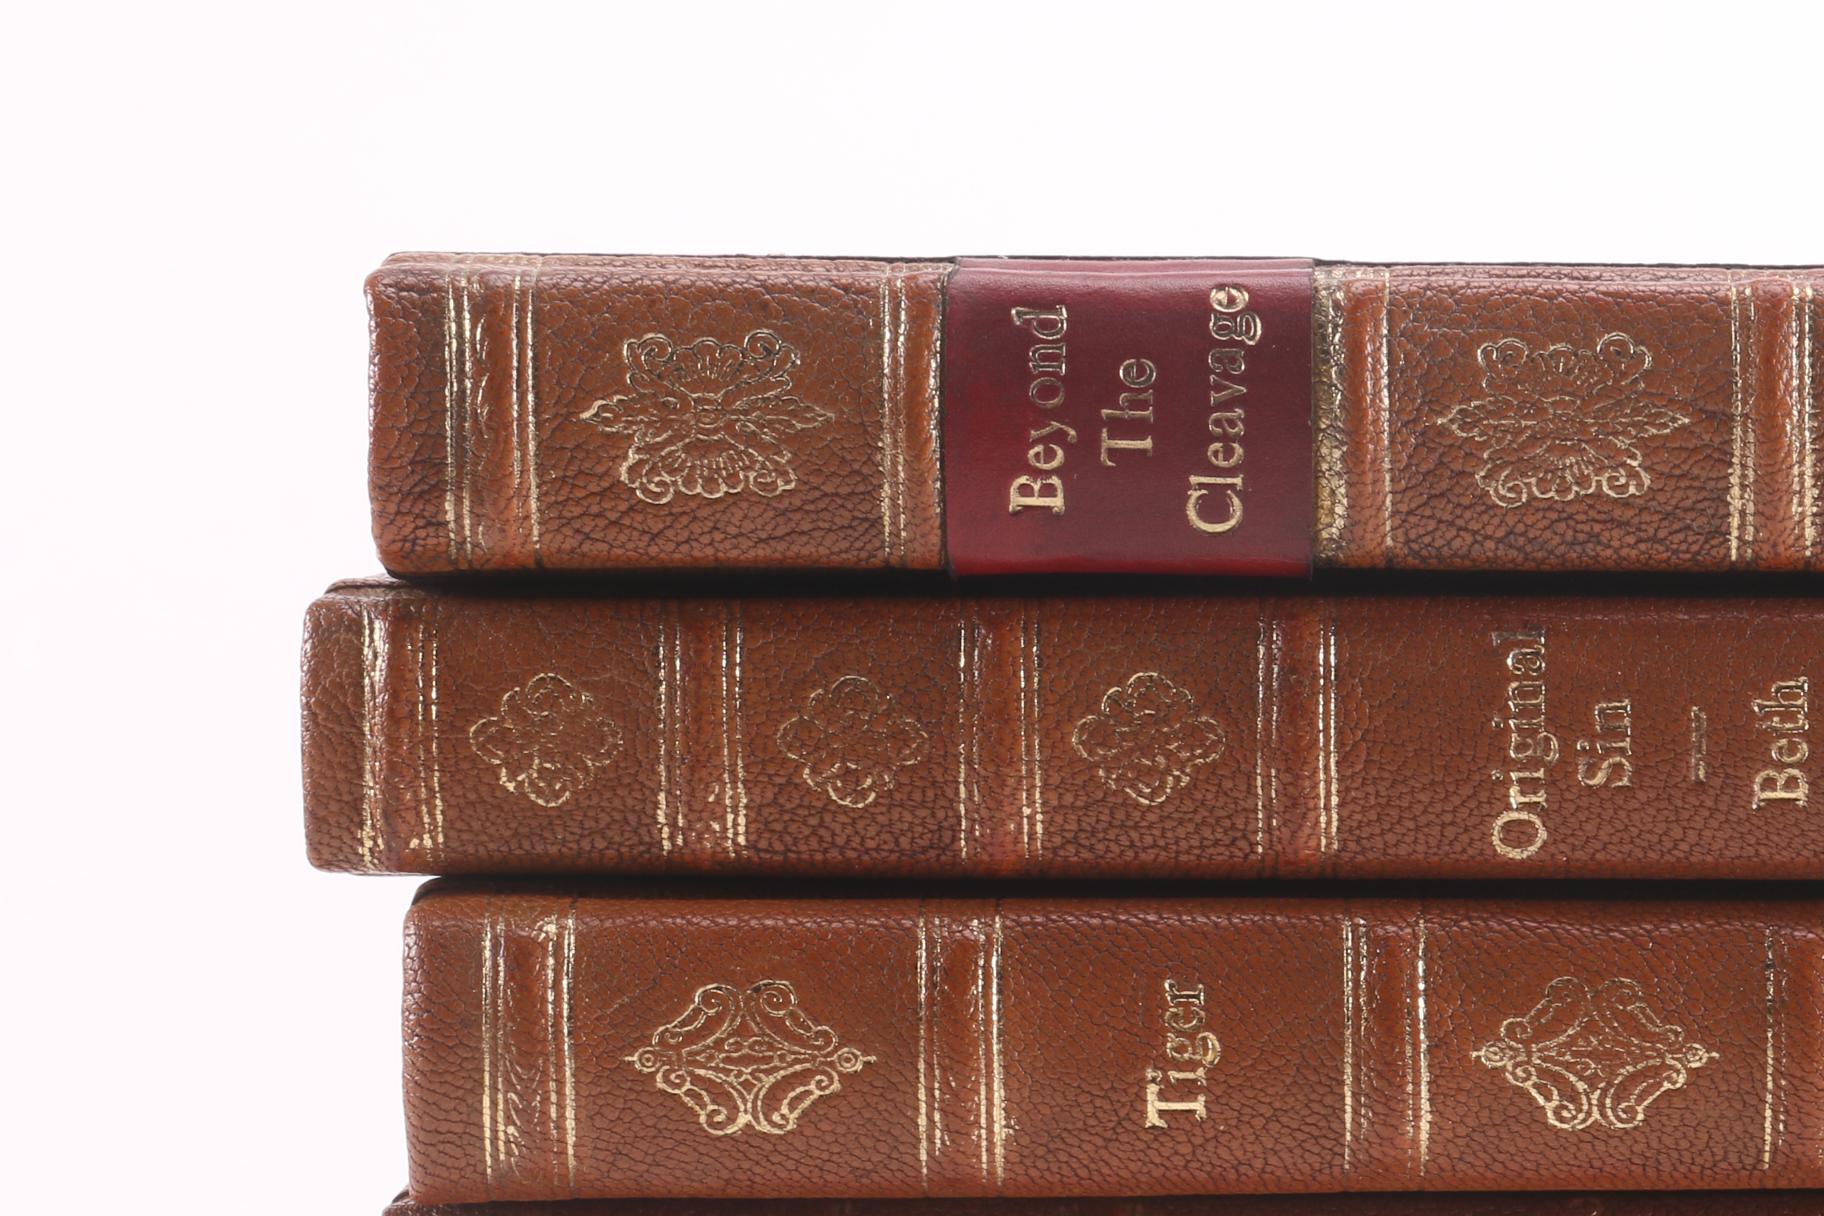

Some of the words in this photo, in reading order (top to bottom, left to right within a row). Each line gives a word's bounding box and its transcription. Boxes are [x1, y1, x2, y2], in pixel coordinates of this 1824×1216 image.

[1009, 305, 1077, 515] Beyond
[1100, 358, 1156, 466] The
[1185, 284, 1262, 534] Cleavage
[1491, 628, 1559, 859] Original
[1577, 698, 1633, 788] Sin
[1752, 676, 1809, 810] Beth
[1145, 979, 1221, 1128] Tiger
